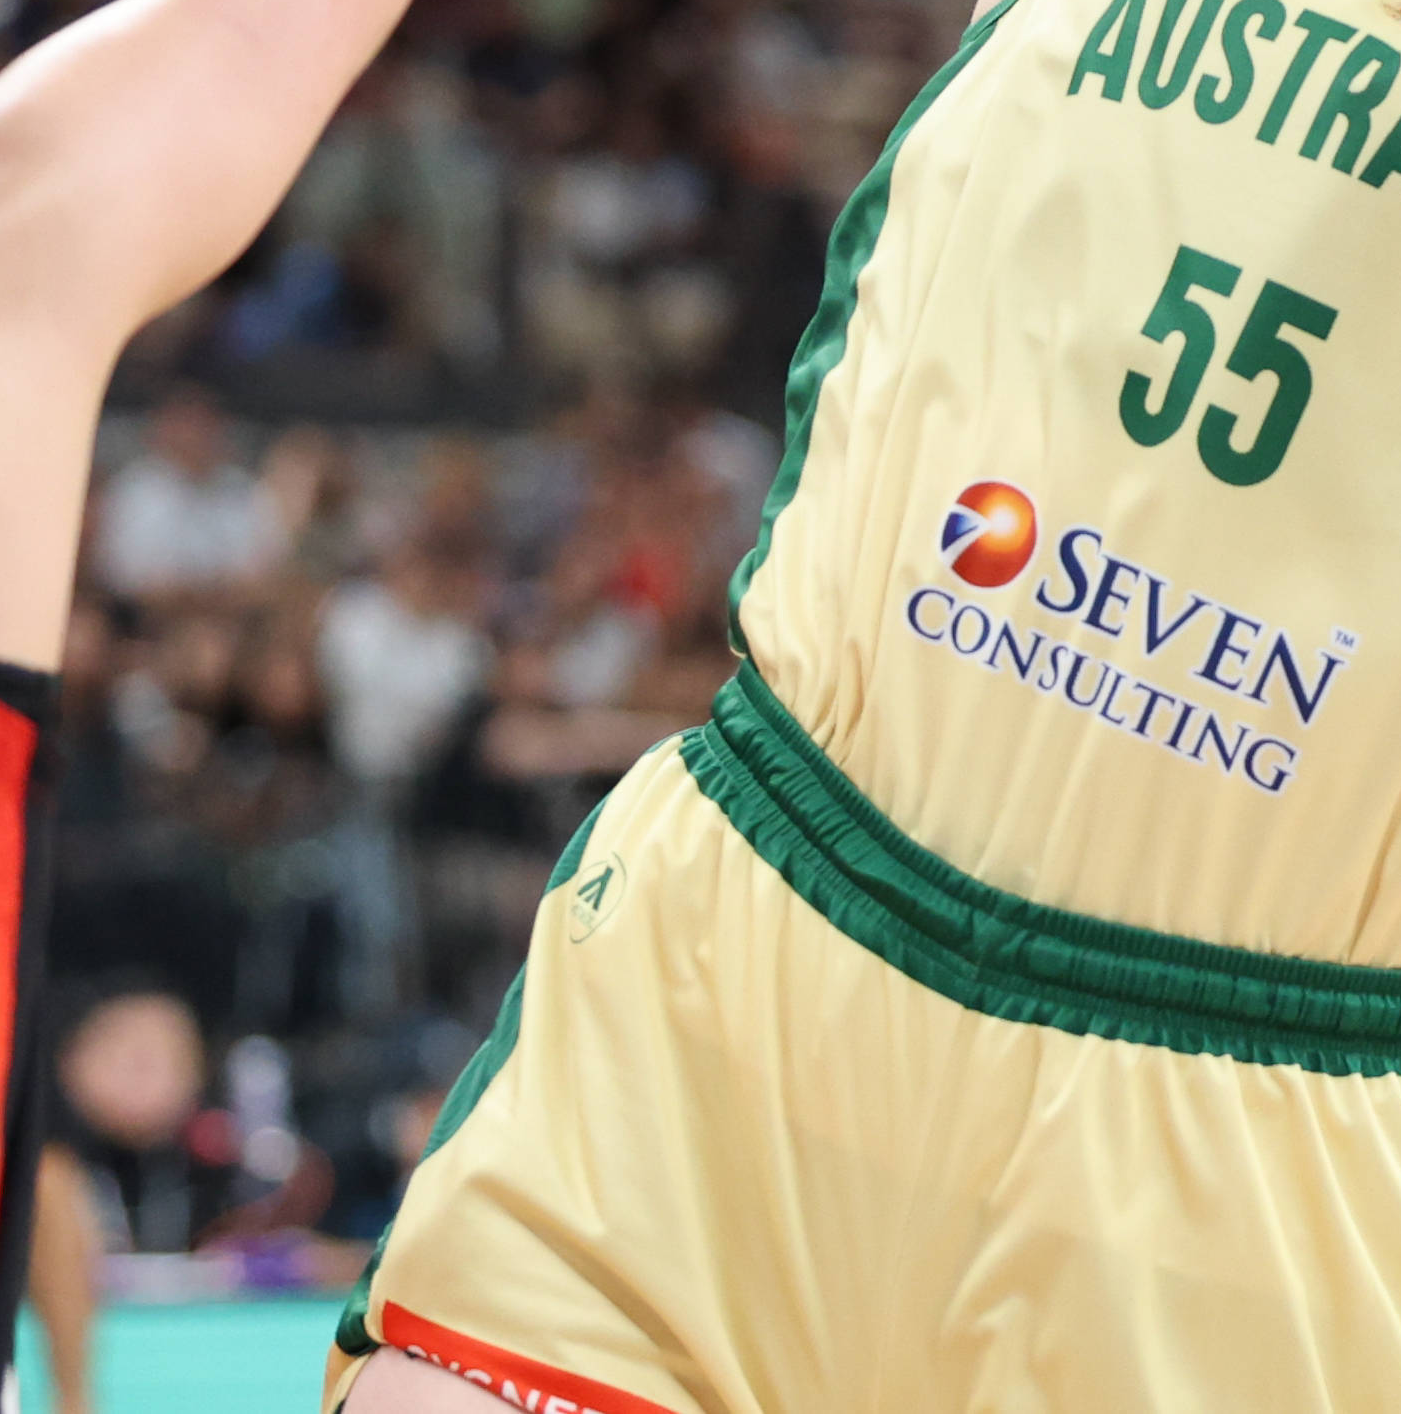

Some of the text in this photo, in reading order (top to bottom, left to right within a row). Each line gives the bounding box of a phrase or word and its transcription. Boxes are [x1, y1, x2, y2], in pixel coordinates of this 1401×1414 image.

[1118, 243, 1339, 487] 55
[906, 588, 1298, 793] CONSULTING
[1035, 528, 1346, 724] SEVEN
